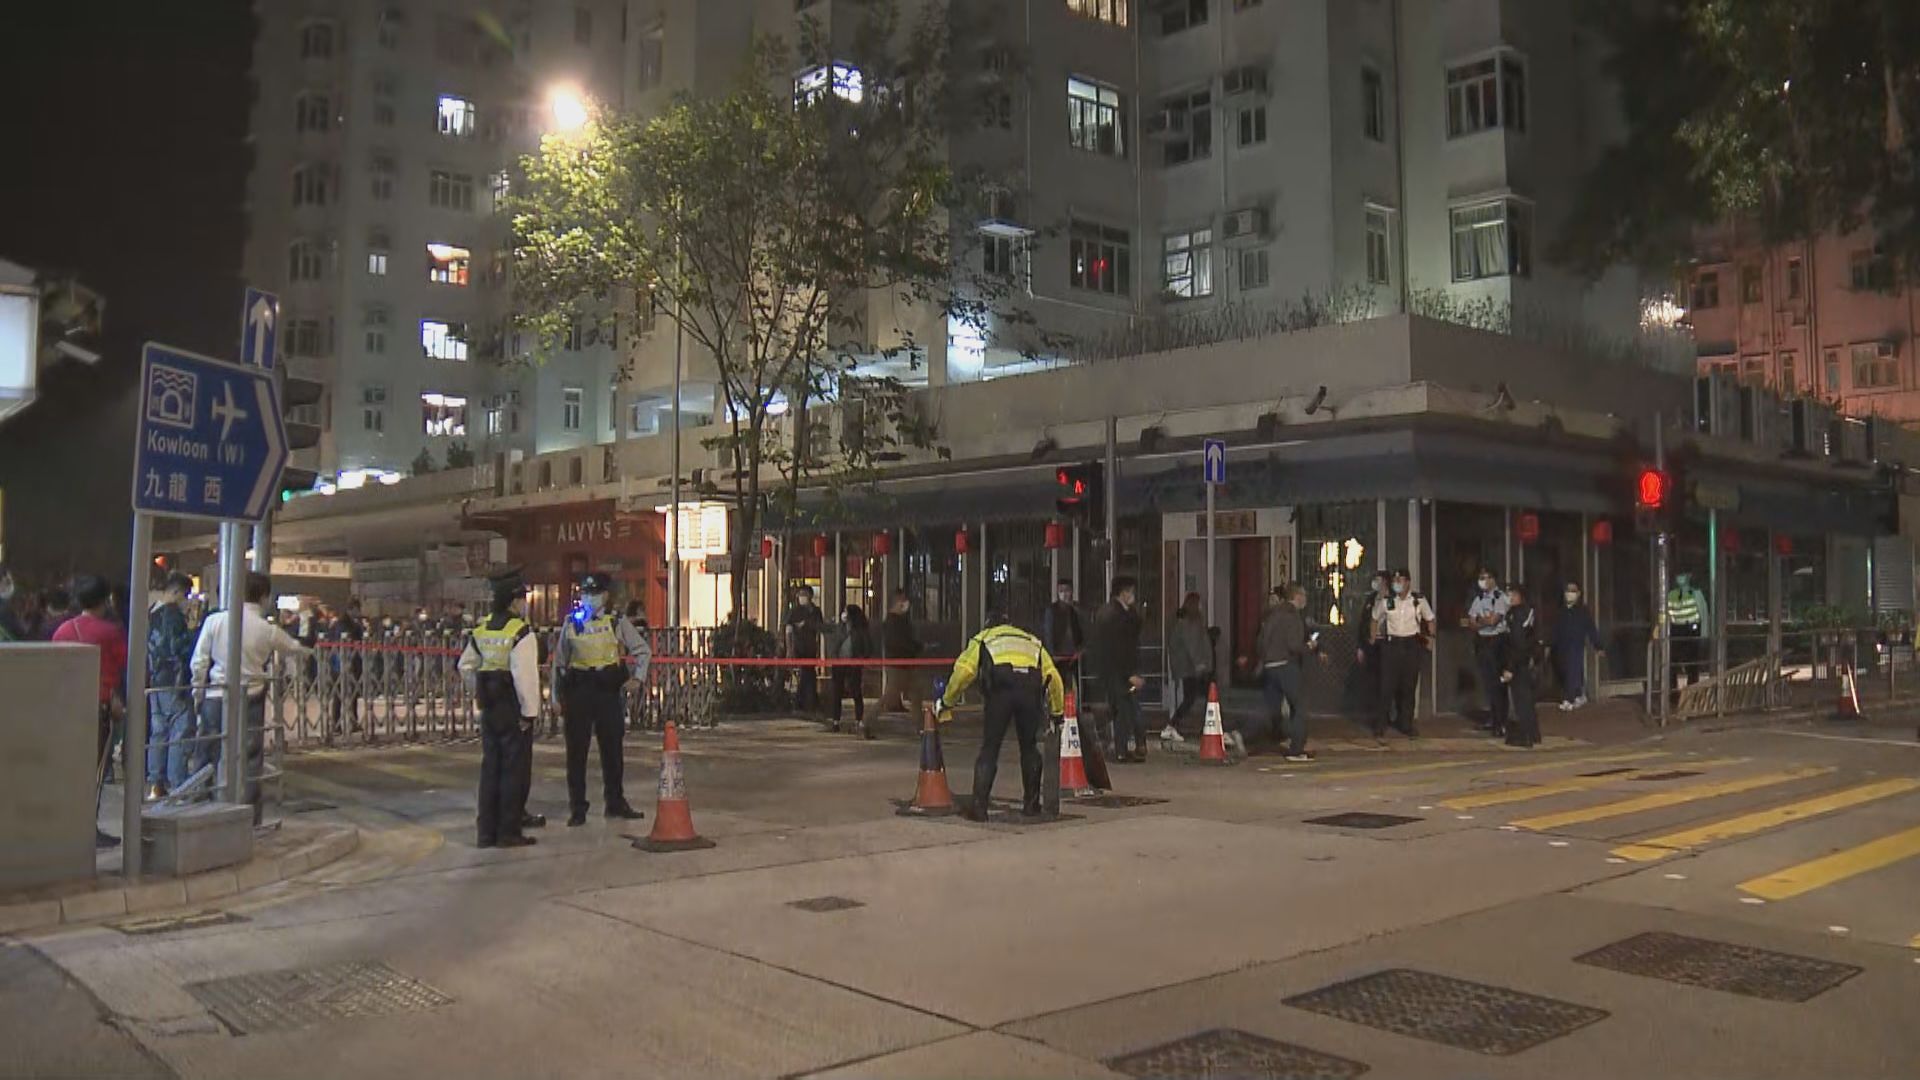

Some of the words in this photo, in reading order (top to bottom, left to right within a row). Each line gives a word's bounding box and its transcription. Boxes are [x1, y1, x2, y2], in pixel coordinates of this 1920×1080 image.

[147, 428, 208, 459] Kowloon
[217, 442, 244, 464] (W)
[558, 520, 612, 543] ALVY'S
